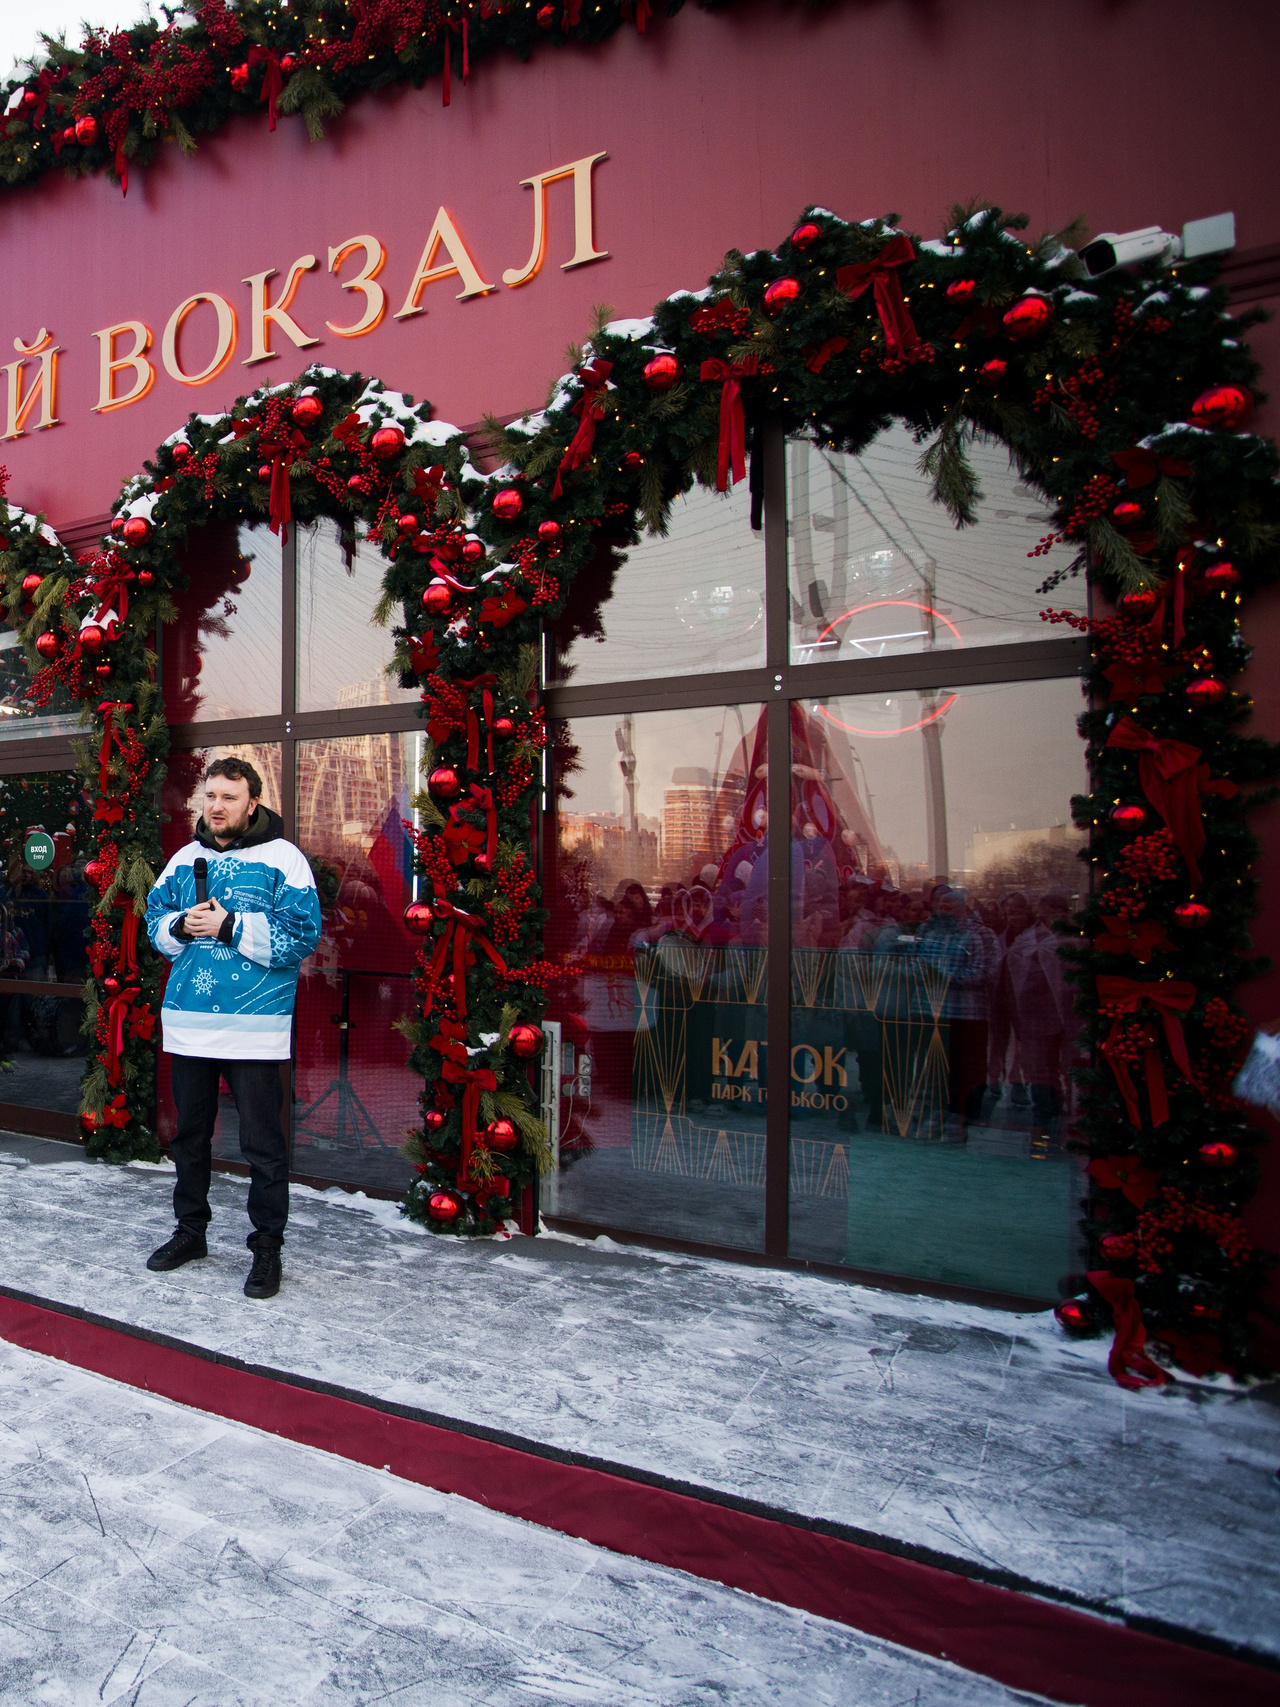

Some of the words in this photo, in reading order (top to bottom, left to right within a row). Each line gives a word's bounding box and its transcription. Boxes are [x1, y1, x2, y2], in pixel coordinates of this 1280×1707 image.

[90, 151, 609, 413] ВОКЗАЛ
[30, 846, 47, 854] ВХОД
[712, 1037, 848, 1087] КАОК
[712, 1083, 752, 1102] ПАРК
[758, 1087, 848, 1111] ГЬКОГО
